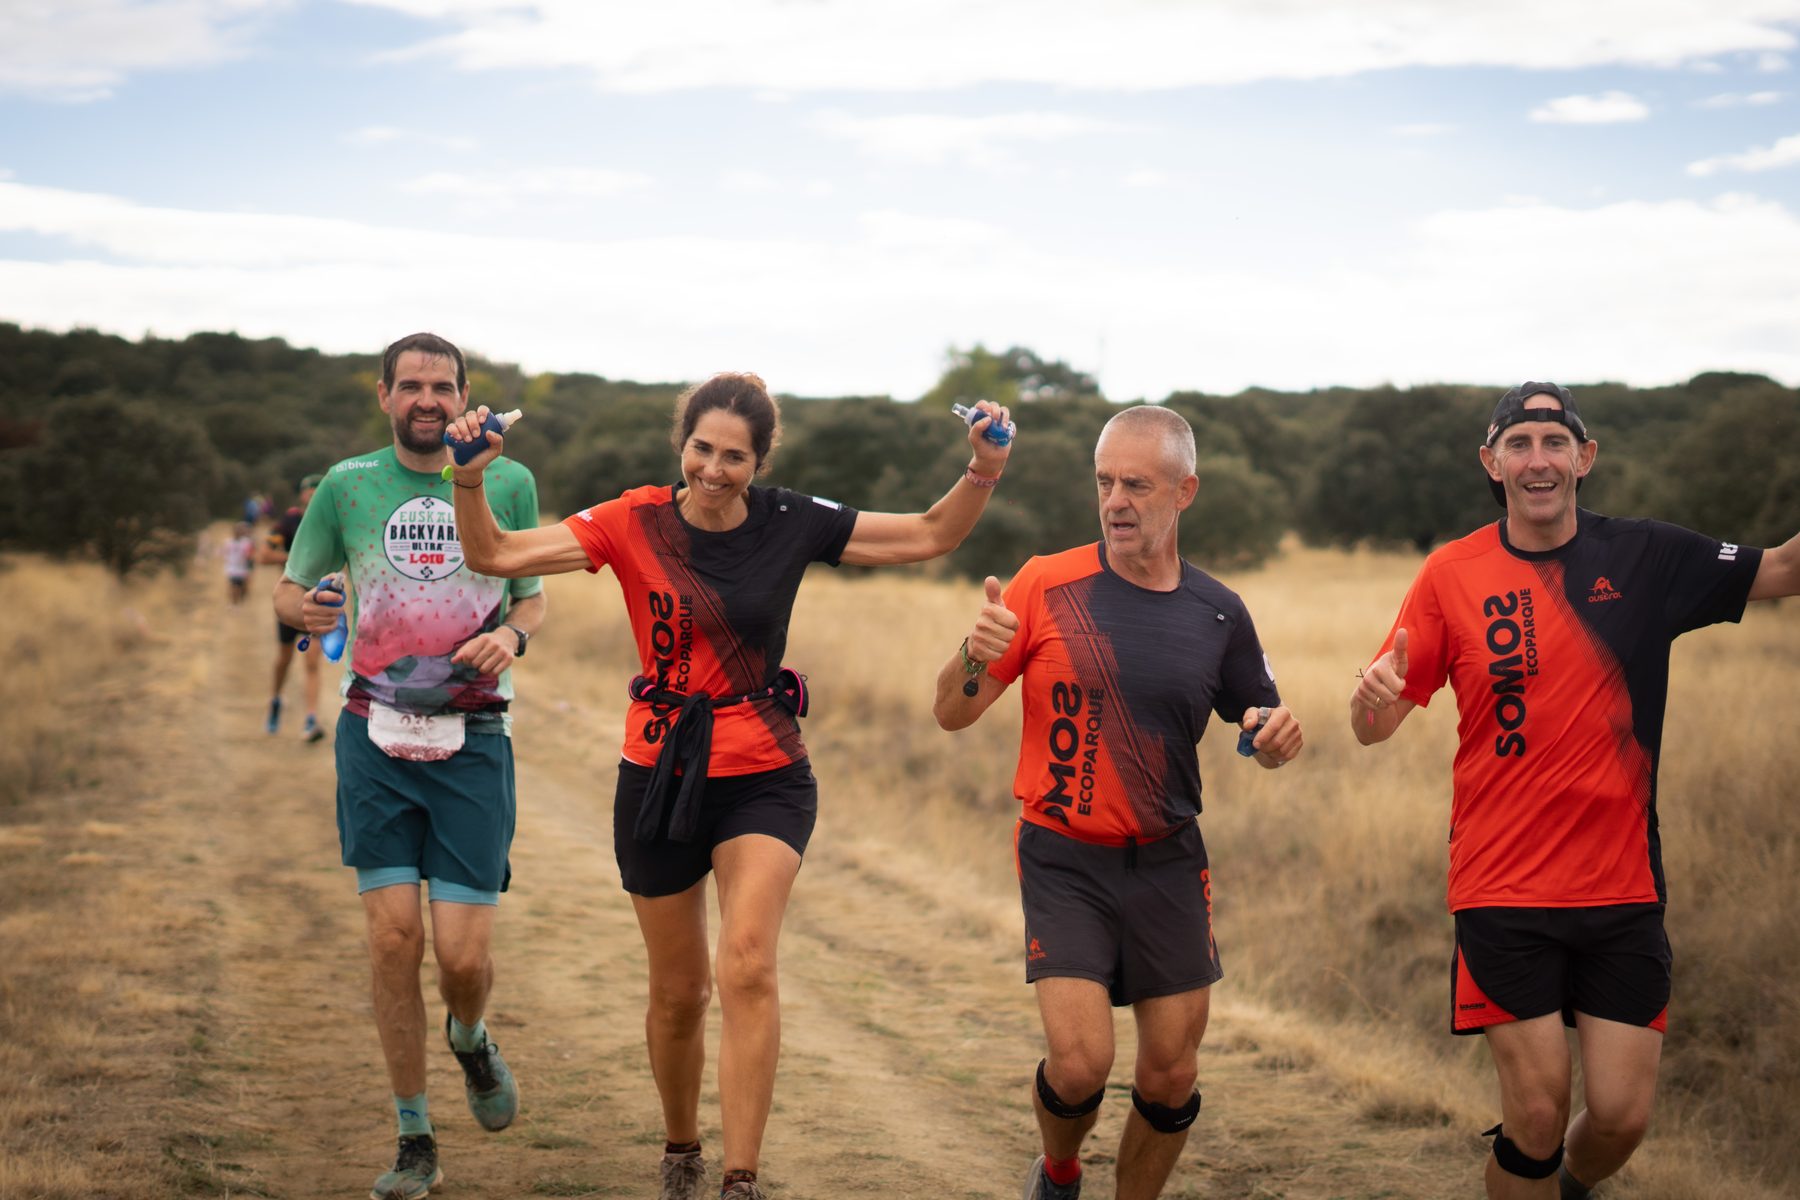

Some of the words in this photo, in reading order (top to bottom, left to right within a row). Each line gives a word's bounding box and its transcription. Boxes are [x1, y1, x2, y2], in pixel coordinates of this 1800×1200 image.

[390, 525, 459, 541] BACKYAR
[399, 511, 454, 523] EUSKAL
[409, 553, 445, 564] LOIU
[412, 542, 443, 551] ULTRA
[675, 594, 693, 692] ECOPARQUE
[1519, 588, 1539, 676] ECOPARQUE
[1482, 590, 1527, 758] SOMOS
[1077, 687, 1104, 817] ECOPARQUE
